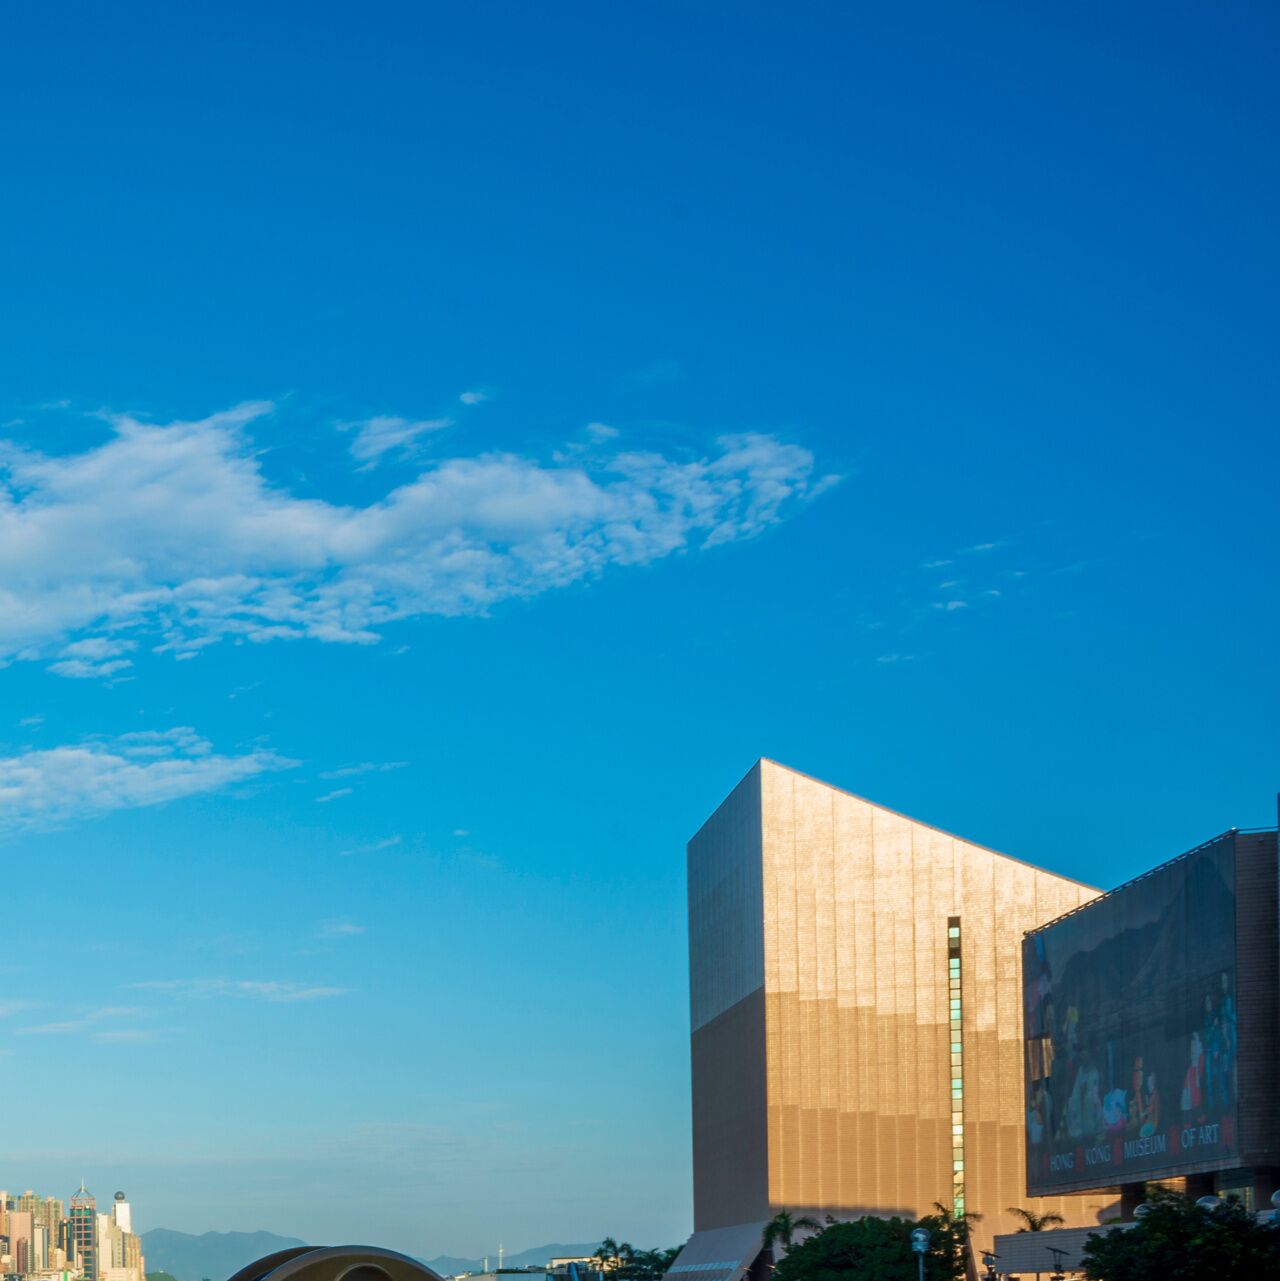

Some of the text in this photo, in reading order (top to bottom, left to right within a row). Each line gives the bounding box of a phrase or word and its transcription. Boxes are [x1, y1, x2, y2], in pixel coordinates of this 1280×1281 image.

[1050, 1152, 1074, 1171] HONG
[1085, 1145, 1112, 1166] KONG
[1124, 1134, 1168, 1160] MUSEUM
[1181, 1128, 1197, 1148] OF
[1198, 1123, 1220, 1145] ART
